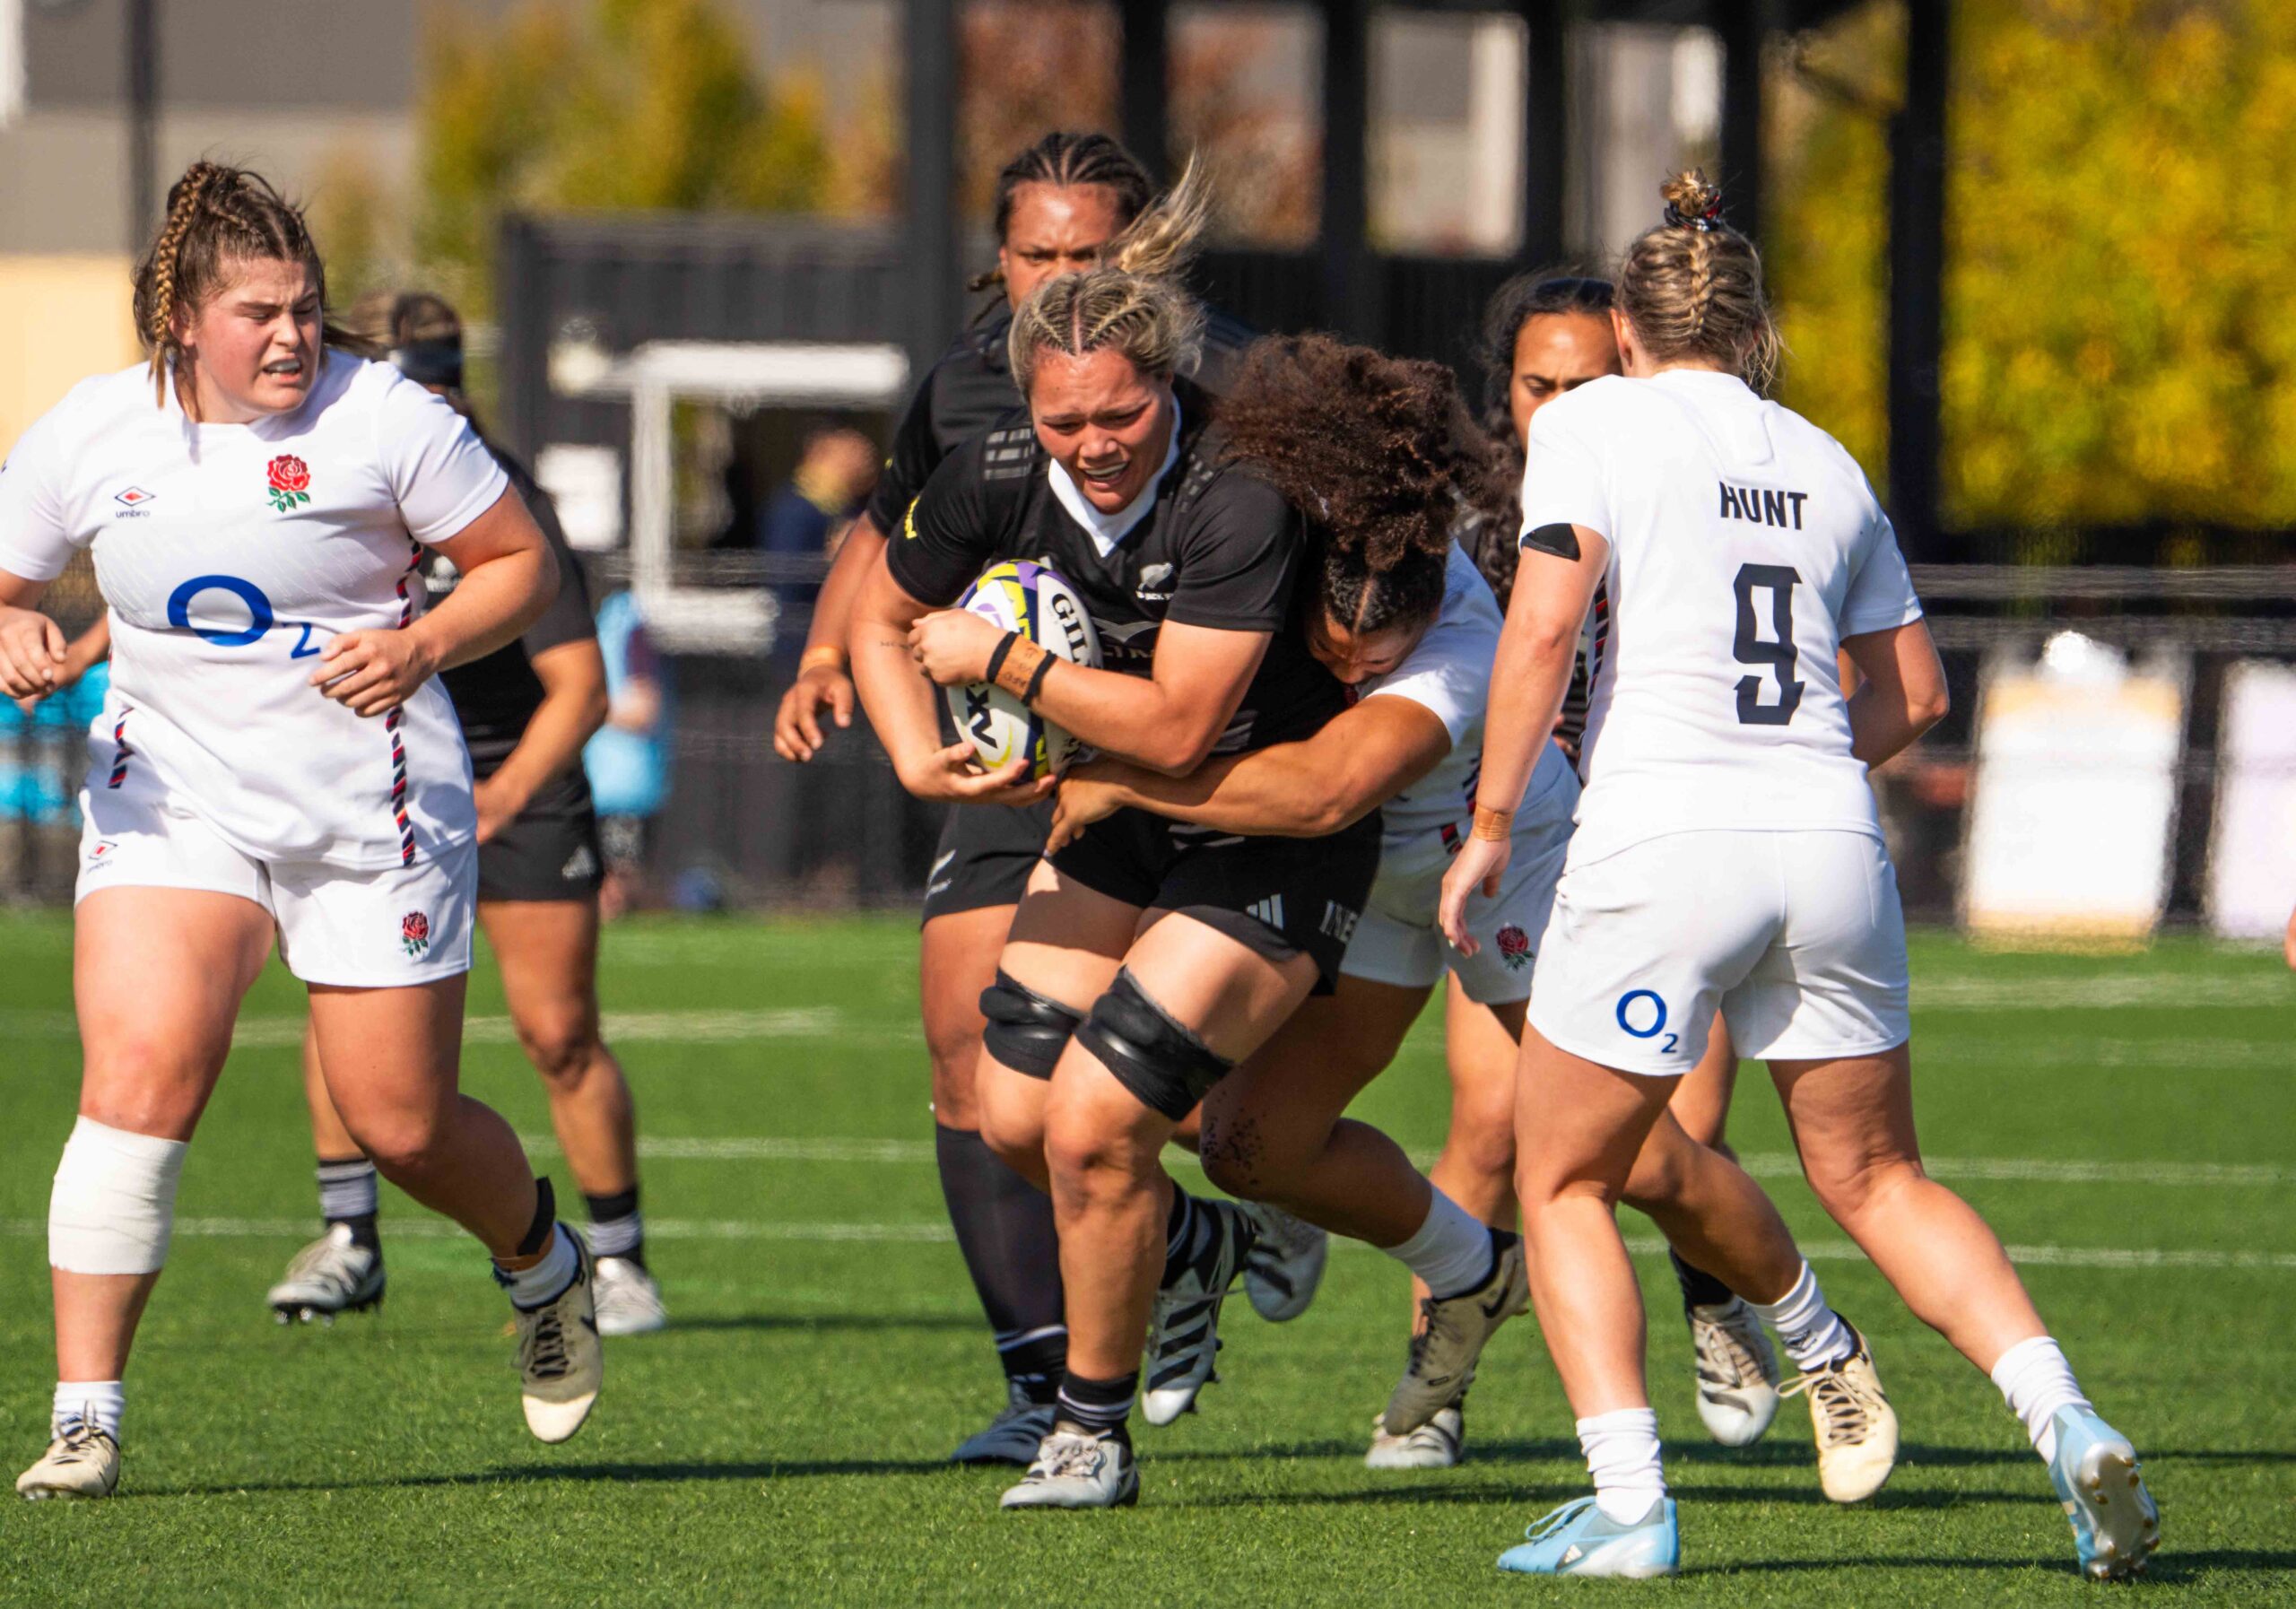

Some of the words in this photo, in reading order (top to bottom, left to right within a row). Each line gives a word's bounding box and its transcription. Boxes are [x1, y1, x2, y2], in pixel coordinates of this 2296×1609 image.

[1719, 482, 1808, 530] HUNT
[1733, 563, 1805, 726] 9
[965, 682, 998, 749] XV
